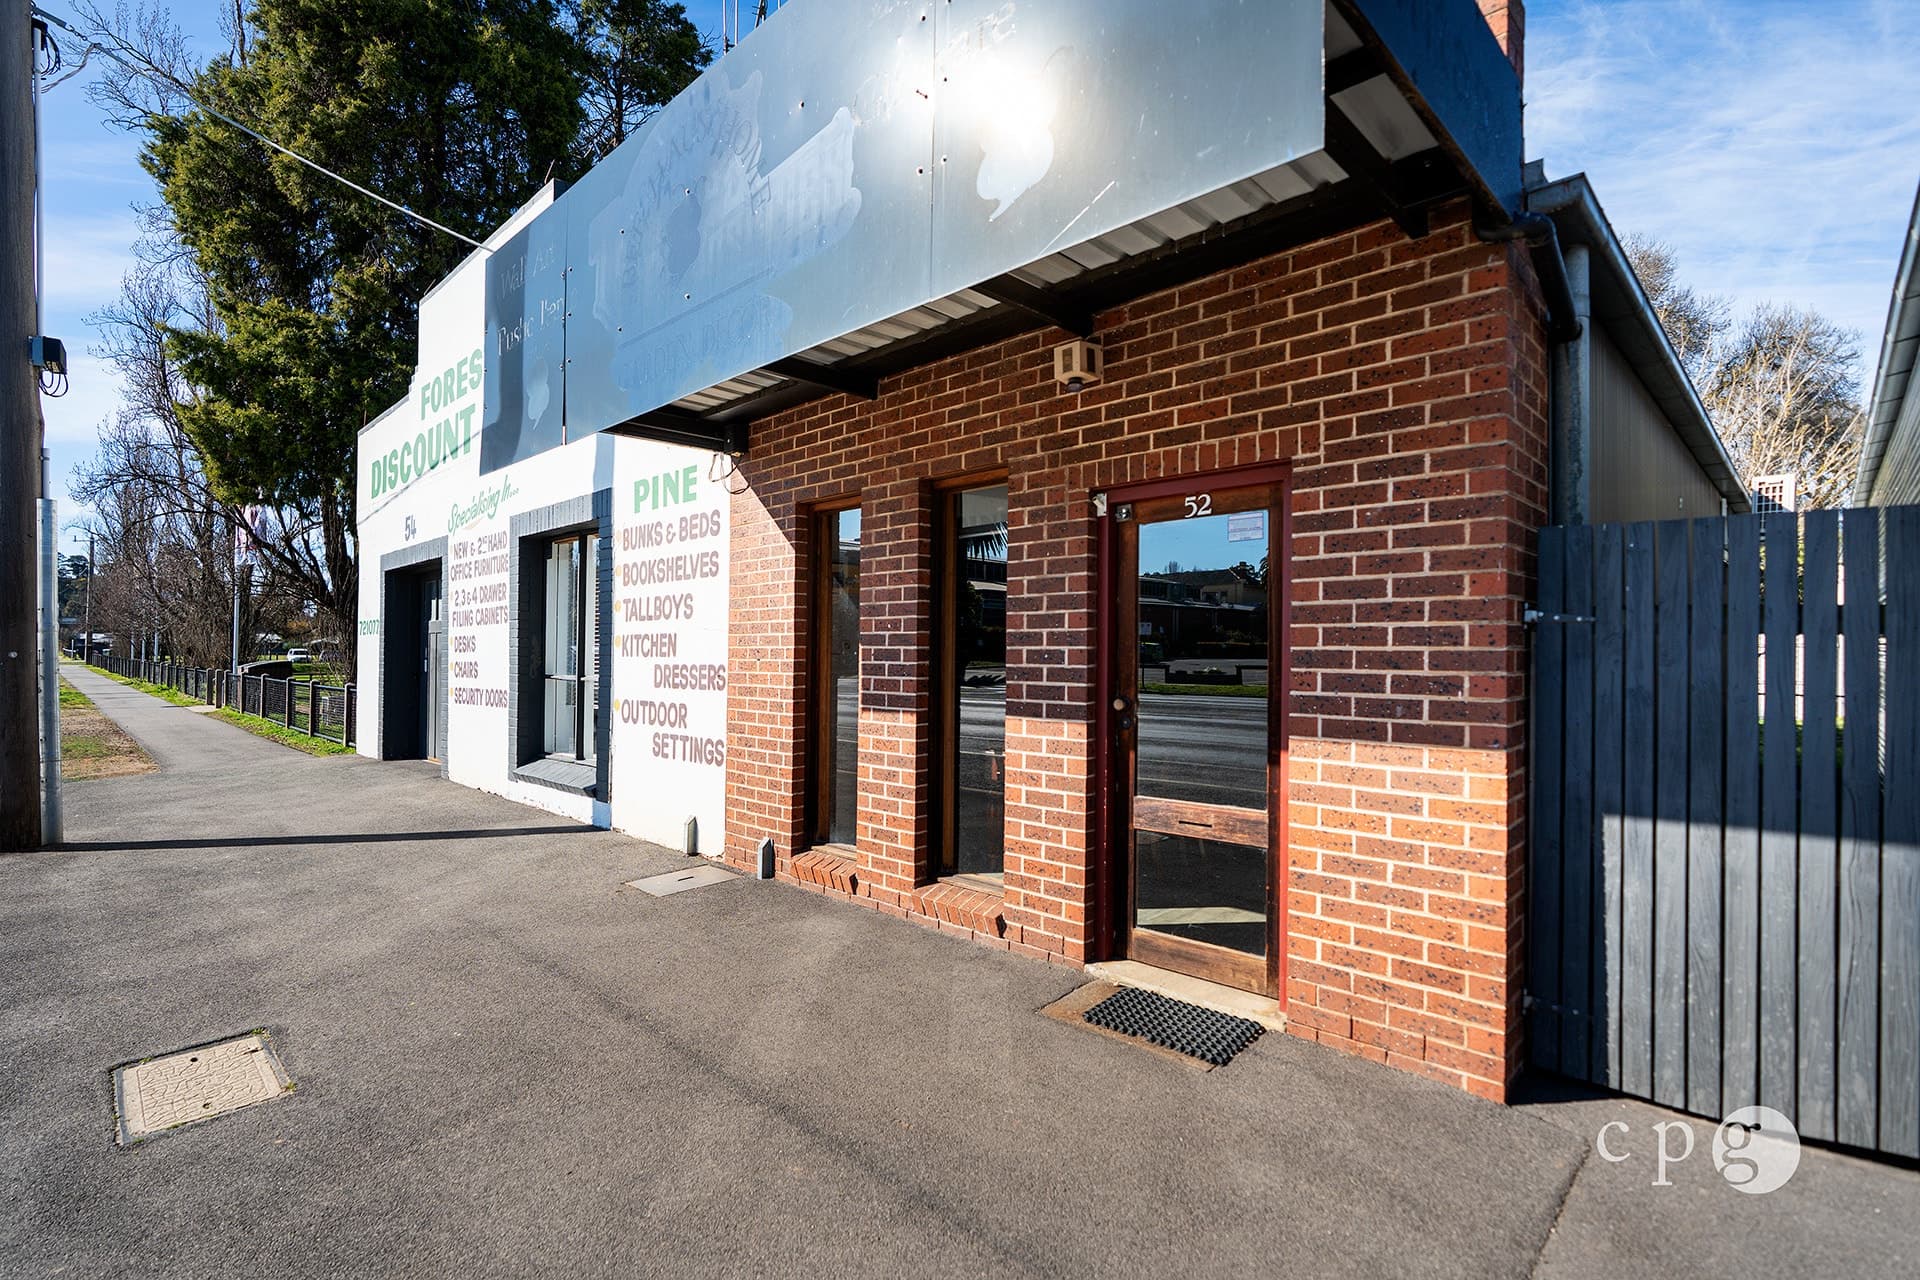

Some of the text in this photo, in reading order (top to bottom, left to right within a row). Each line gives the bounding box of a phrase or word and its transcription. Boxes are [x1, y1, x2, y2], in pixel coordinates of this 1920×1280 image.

[420, 348, 483, 421] FORES
[371, 404, 476, 499] DISCOUNT
[633, 464, 698, 514] PINE
[448, 487, 501, 536] Specialising
[1183, 493, 1213, 519] 52
[404, 514, 417, 542] 54
[622, 508, 721, 552] BUNKS & BEDS
[453, 541, 469, 560] NEW
[488, 530, 508, 552] HAND
[450, 553, 509, 582] OFFICE FURNITURE
[622, 550, 720, 587] BOOKSHELVES
[479, 582, 507, 604] DRAWER
[622, 592, 694, 623] TALLBOYS
[359, 619, 380, 635] 721077
[452, 605, 509, 628] FILING CABINETS
[454, 635, 477, 653] DESKS
[621, 632, 678, 658] KITCHEN
[454, 661, 479, 679] CHAIRS
[653, 663, 727, 692] DRESSERS
[454, 687, 508, 708] SECURITY DOORS
[621, 698, 688, 729] OUTDOOR
[652, 731, 725, 767] SETTINGS
